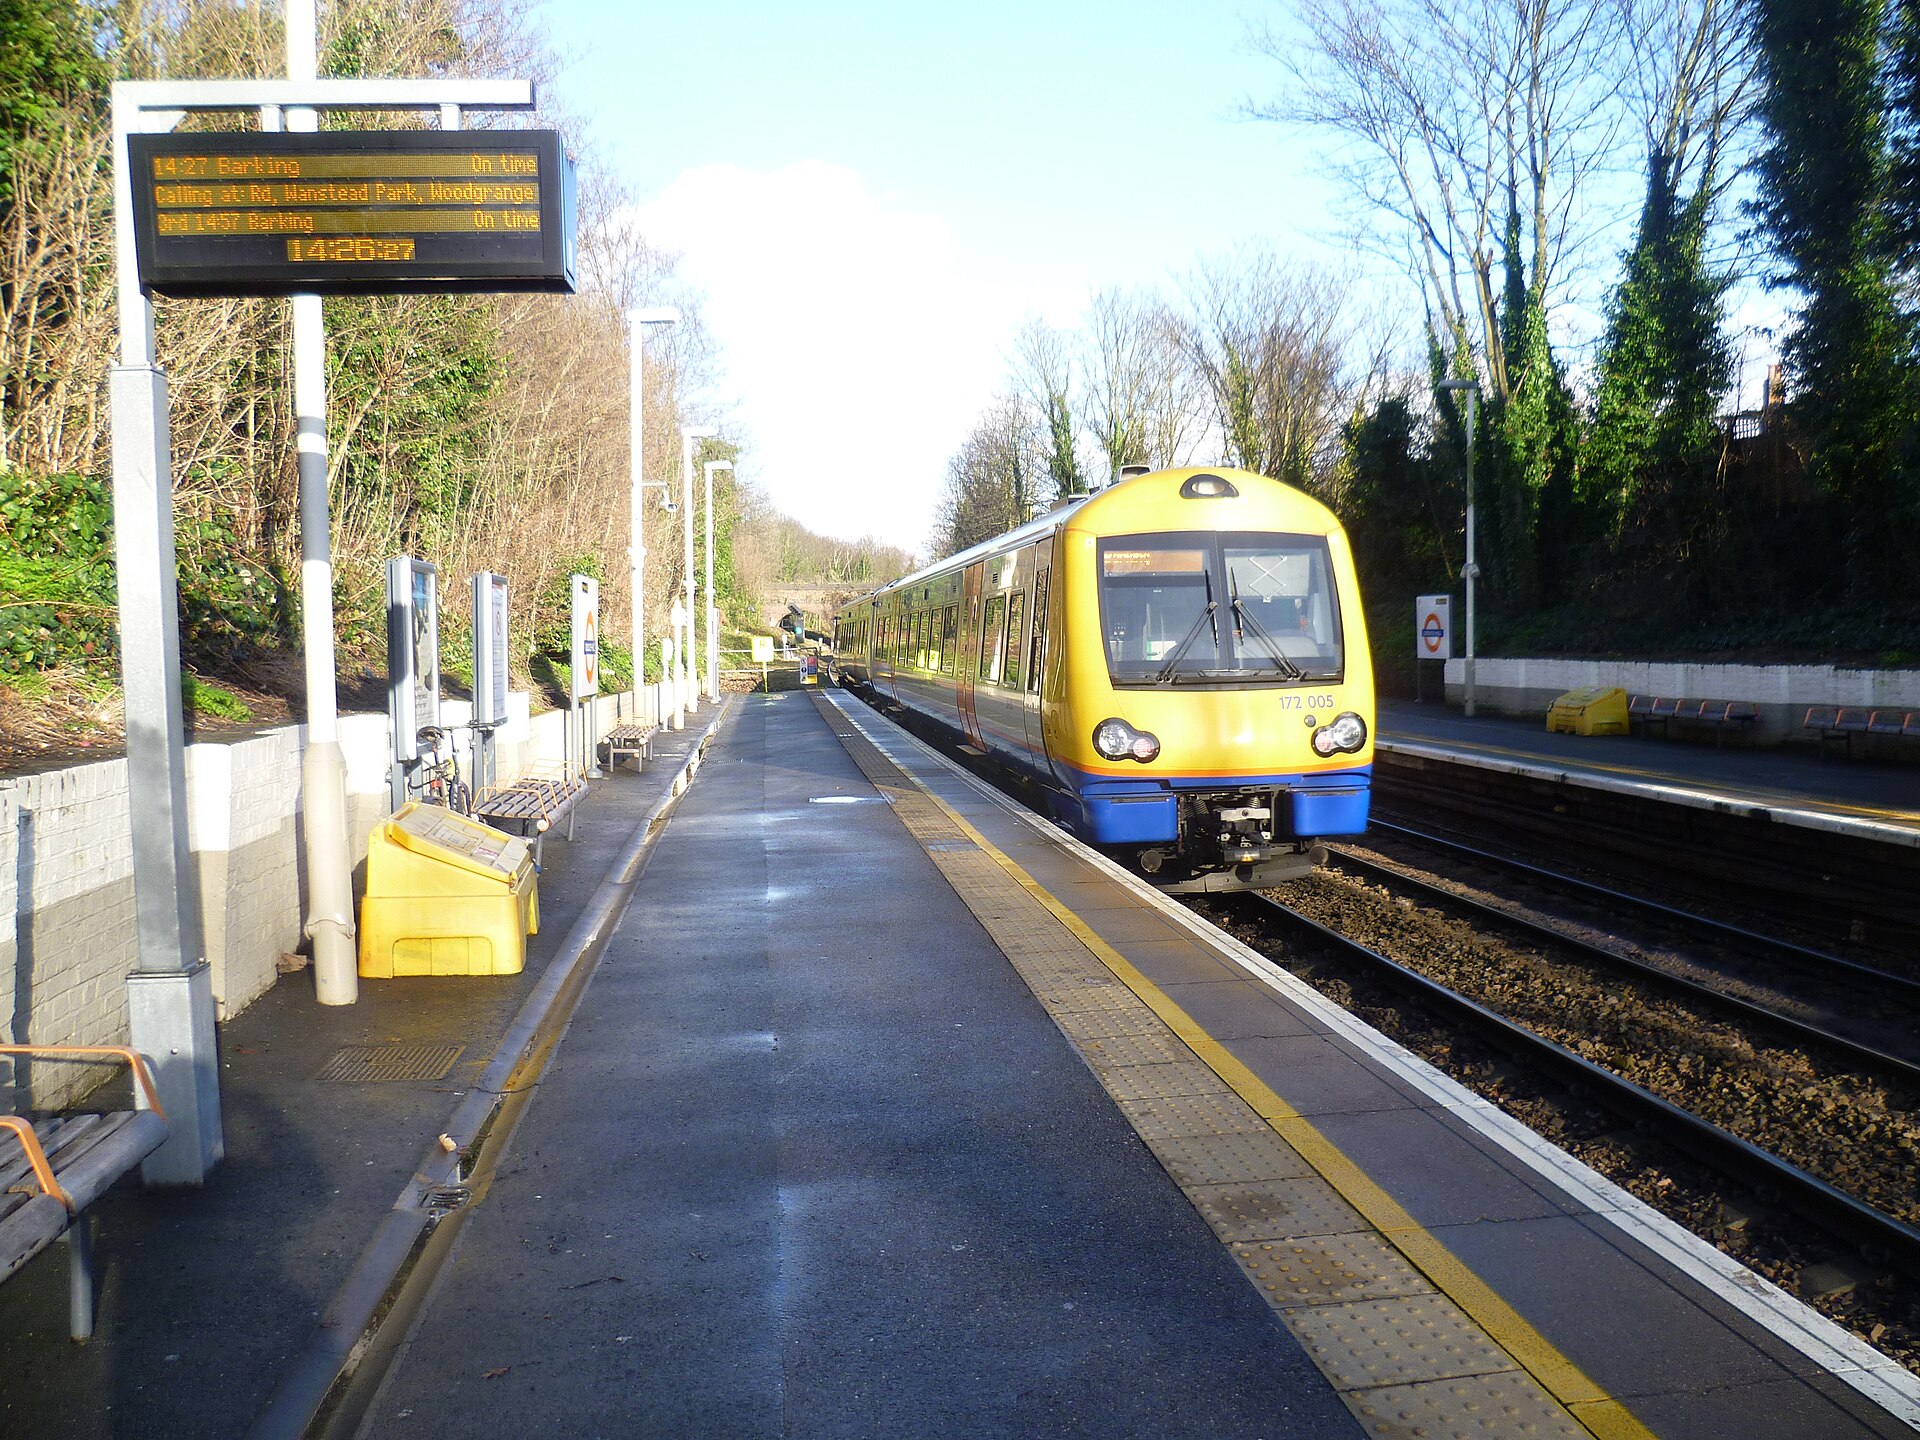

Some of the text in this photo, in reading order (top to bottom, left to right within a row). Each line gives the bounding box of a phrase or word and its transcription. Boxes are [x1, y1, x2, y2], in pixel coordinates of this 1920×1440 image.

[153, 153, 537, 178] 14:27 Barking On time
[155, 185, 213, 207] Calling
[250, 184, 278, 206] Rd,
[284, 182, 368, 202] Wanstead
[375, 182, 423, 205] Park,
[430, 182, 534, 205] Woodgrange
[195, 211, 240, 231] 14:57
[247, 211, 314, 234] Barking
[473, 209, 495, 228] On
[503, 209, 539, 228] time
[291, 236, 416, 262] 14:26:27
[1279, 694, 1334, 709] 172 005
